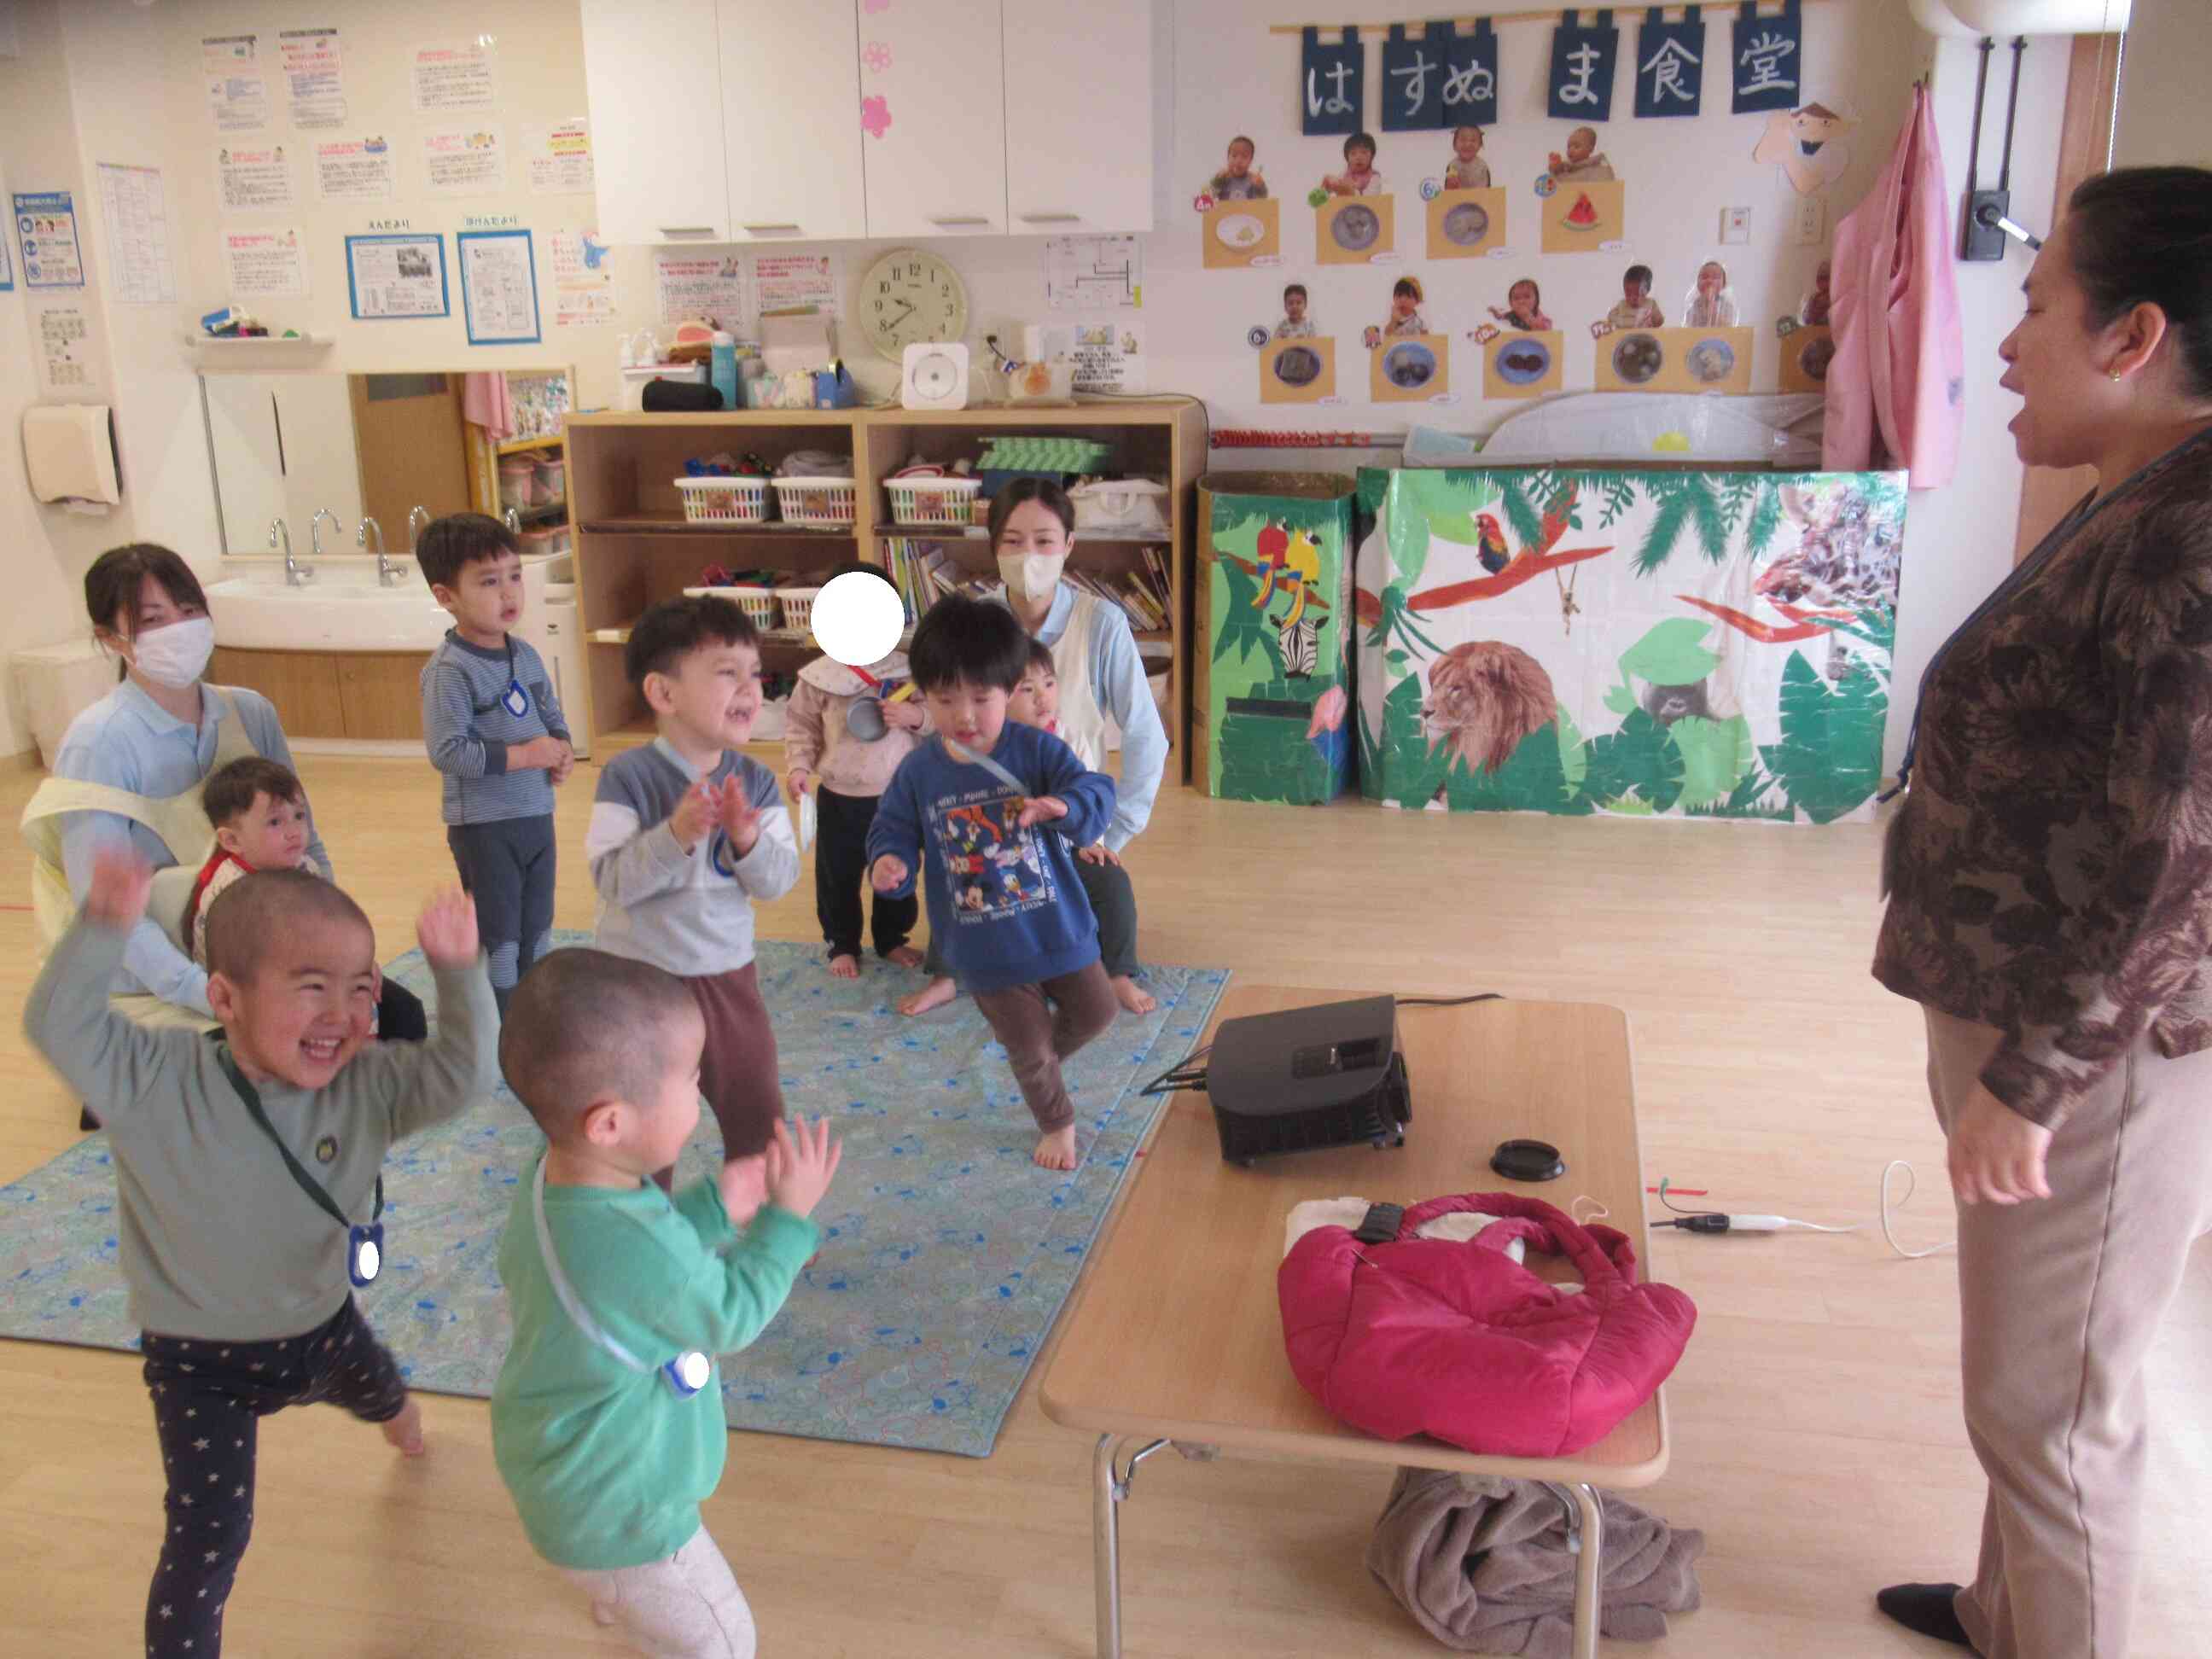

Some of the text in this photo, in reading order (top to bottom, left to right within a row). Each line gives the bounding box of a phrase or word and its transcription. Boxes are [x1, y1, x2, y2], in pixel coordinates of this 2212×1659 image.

[1307, 32, 1797, 117] はすぬま食堂
[892, 266, 901, 281] 11
[908, 262, 922, 276] 12
[880, 281, 891, 294] 10
[942, 283, 950, 297] 2
[875, 299, 883, 312] 9
[946, 303, 953, 317] 3
[880, 319, 888, 333] 8
[892, 333, 900, 346] 7
